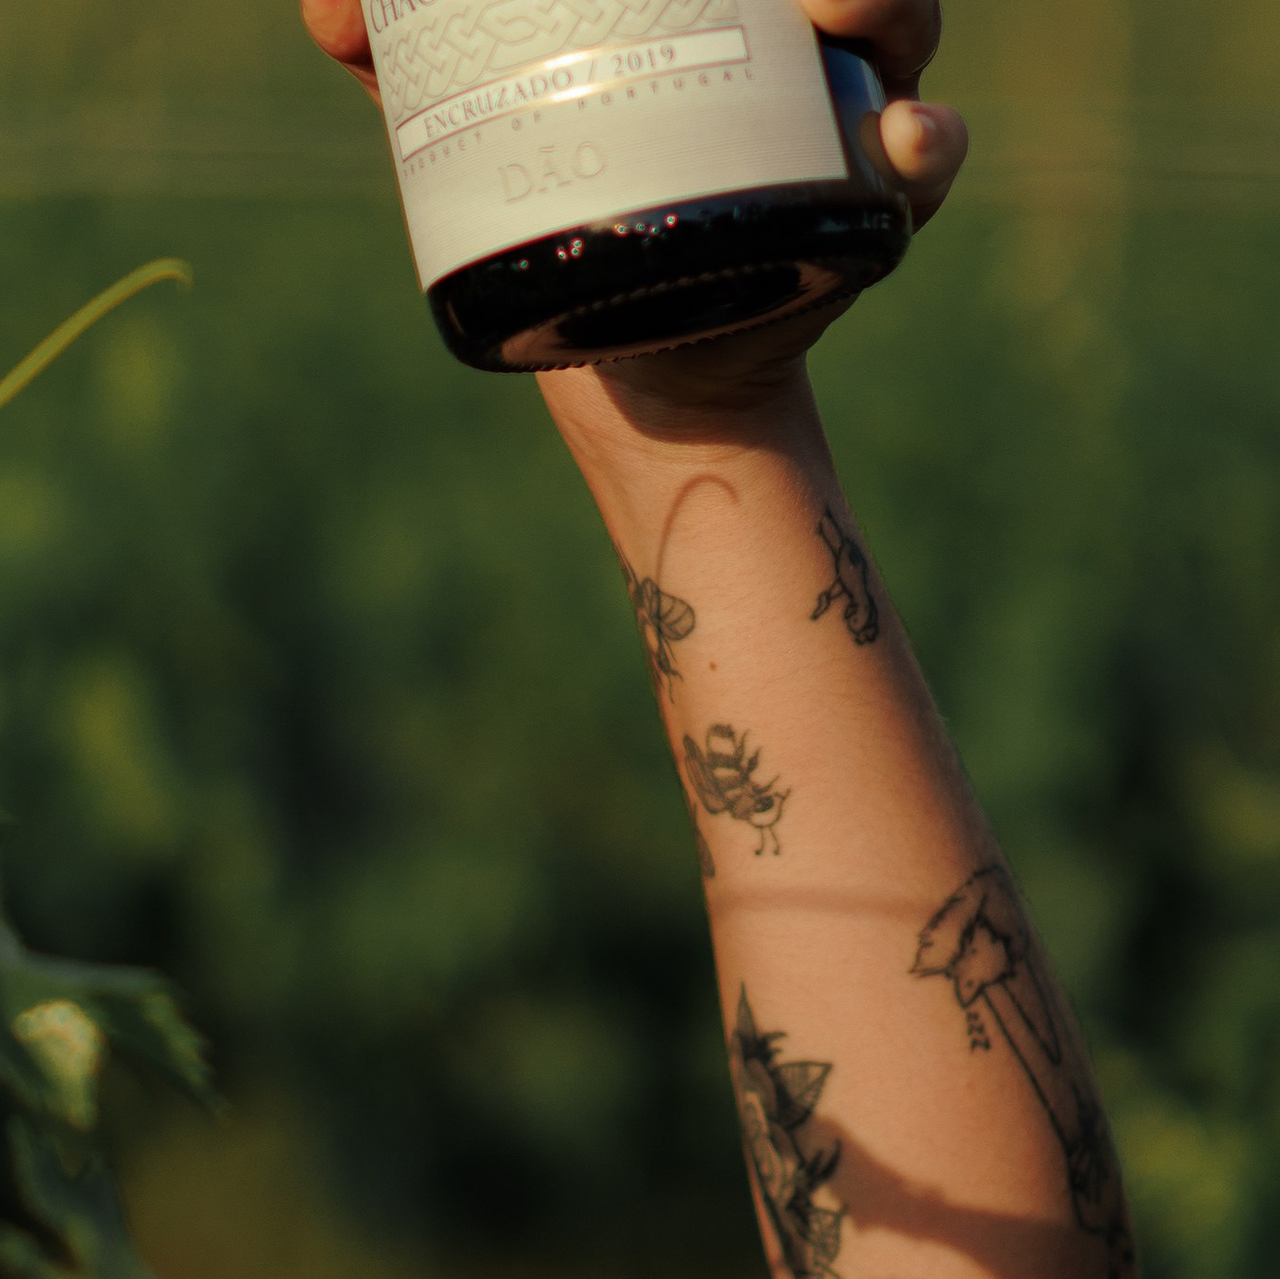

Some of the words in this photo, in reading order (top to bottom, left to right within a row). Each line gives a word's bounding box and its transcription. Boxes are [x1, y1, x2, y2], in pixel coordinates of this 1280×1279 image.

[423, 67, 572, 138] ENCRUZADO
[611, 44, 675, 76] 2019
[402, 130, 483, 179] ODUCT
[497, 141, 606, 204] DÃO
